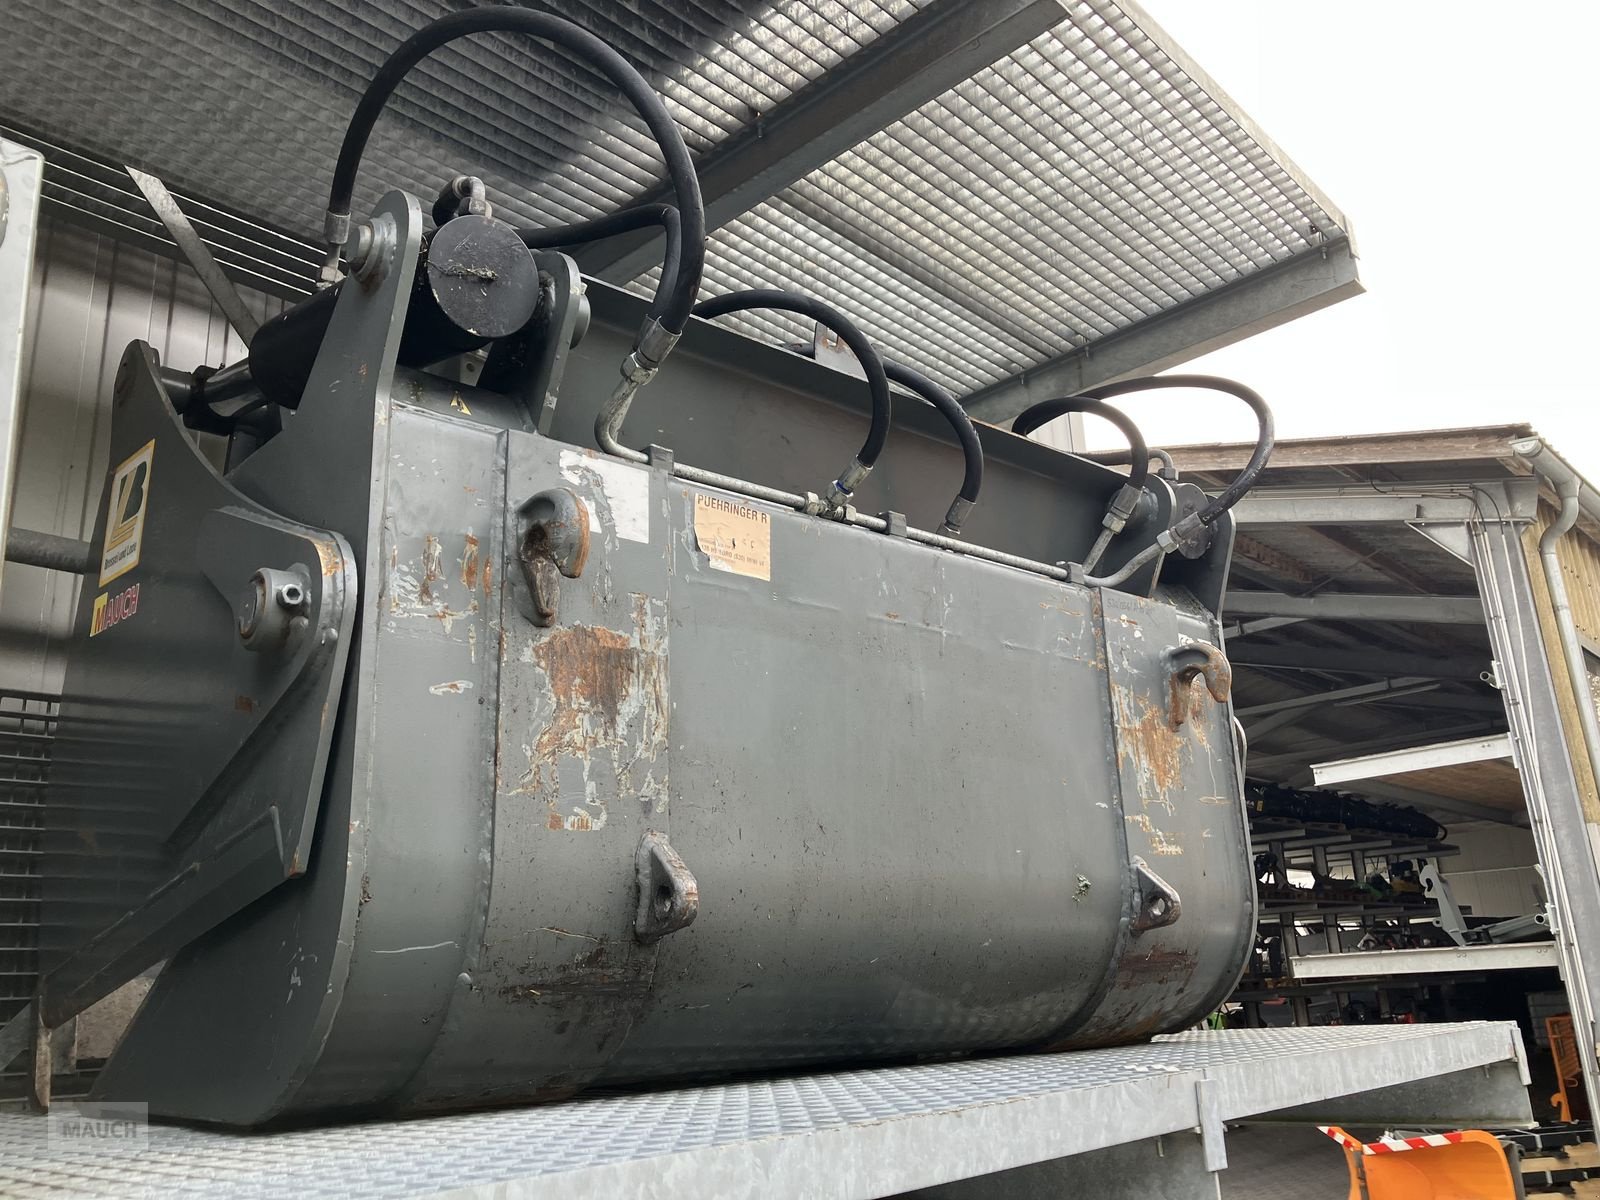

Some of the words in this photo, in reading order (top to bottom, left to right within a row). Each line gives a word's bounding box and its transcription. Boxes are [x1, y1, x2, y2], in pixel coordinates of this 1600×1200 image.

[697, 494, 758, 521] PUEHRINGER
[761, 512, 768, 524] R
[94, 583, 140, 634] MAUCH
